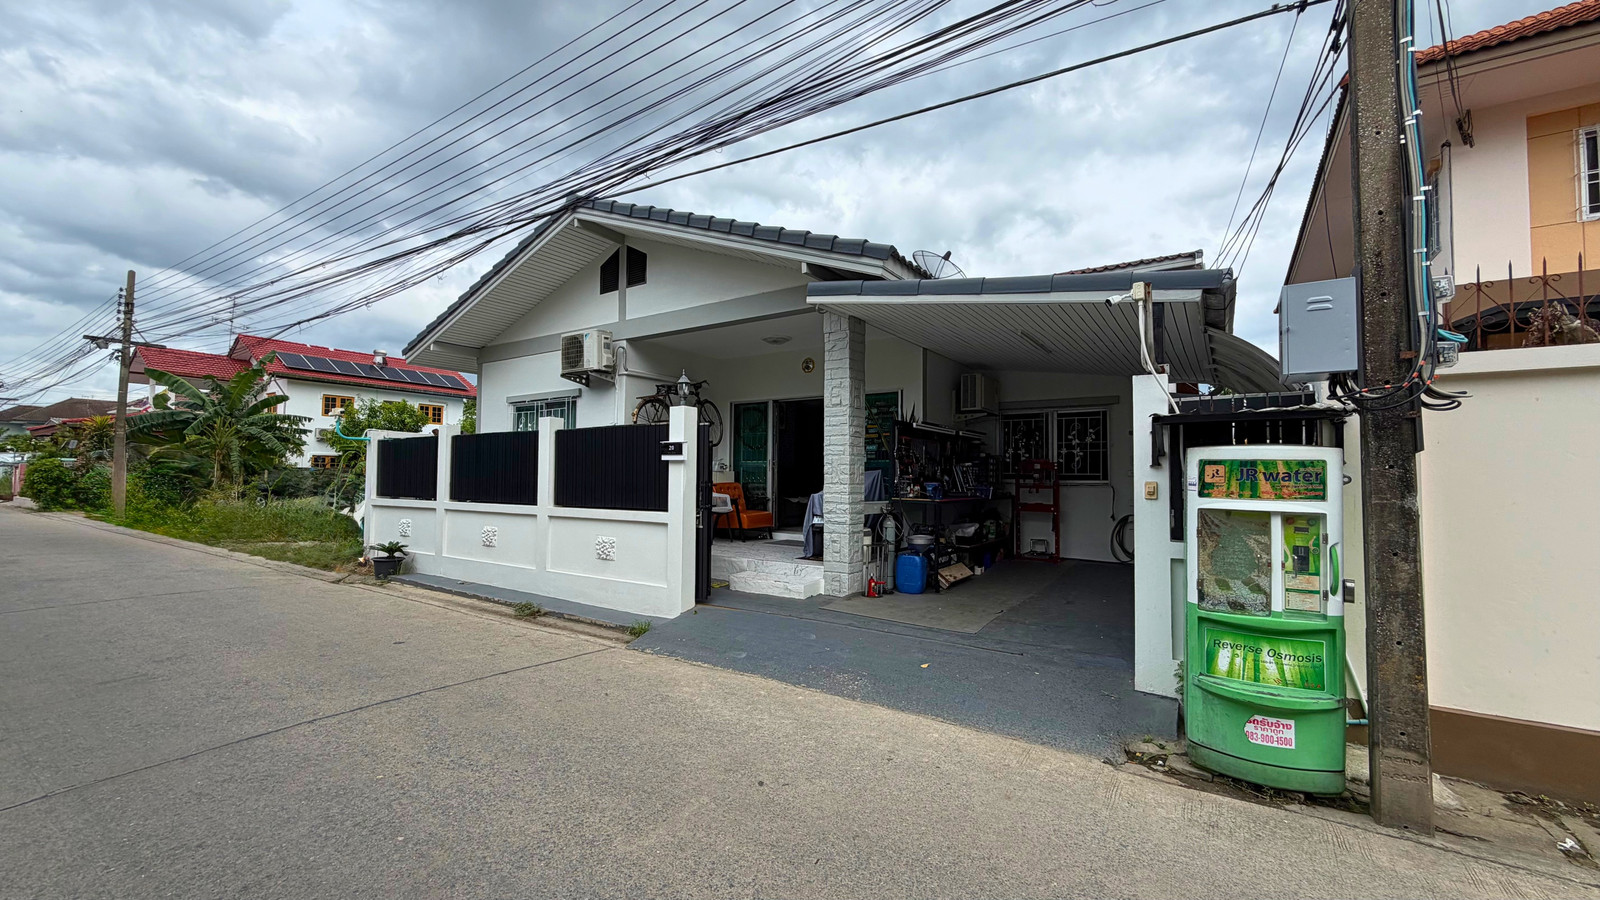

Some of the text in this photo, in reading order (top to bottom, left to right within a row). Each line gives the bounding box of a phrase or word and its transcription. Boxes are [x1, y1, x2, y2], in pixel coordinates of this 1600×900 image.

[1236, 468, 1322, 482] JR water
[1213, 639, 1322, 663] Reverse Osmosis
